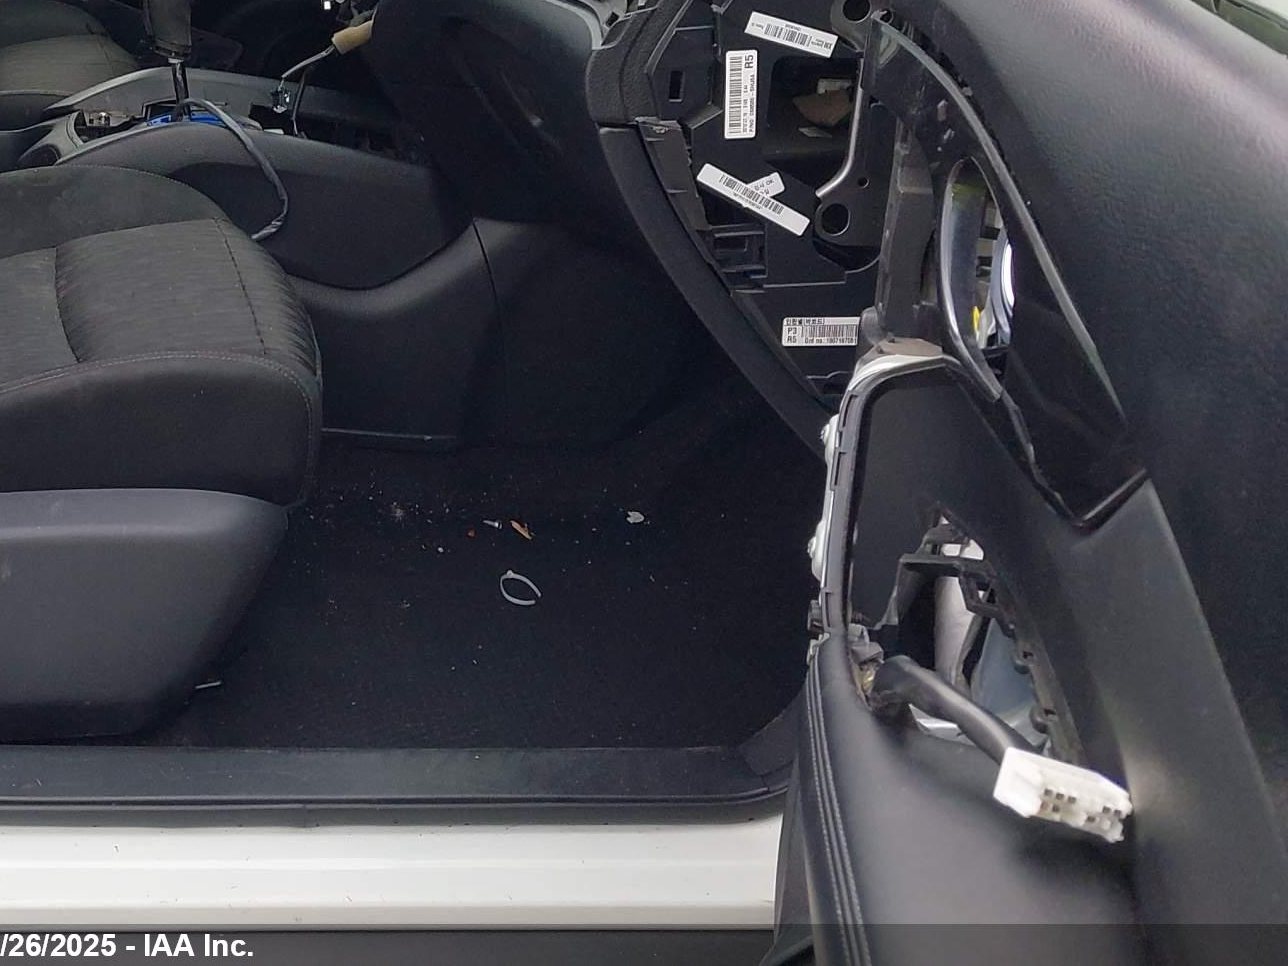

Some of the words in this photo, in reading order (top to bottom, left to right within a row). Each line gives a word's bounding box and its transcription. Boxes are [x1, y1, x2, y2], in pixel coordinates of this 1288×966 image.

[744, 55, 754, 69] R5
[787, 326, 798, 334] P3
[787, 335, 797, 343] R5
